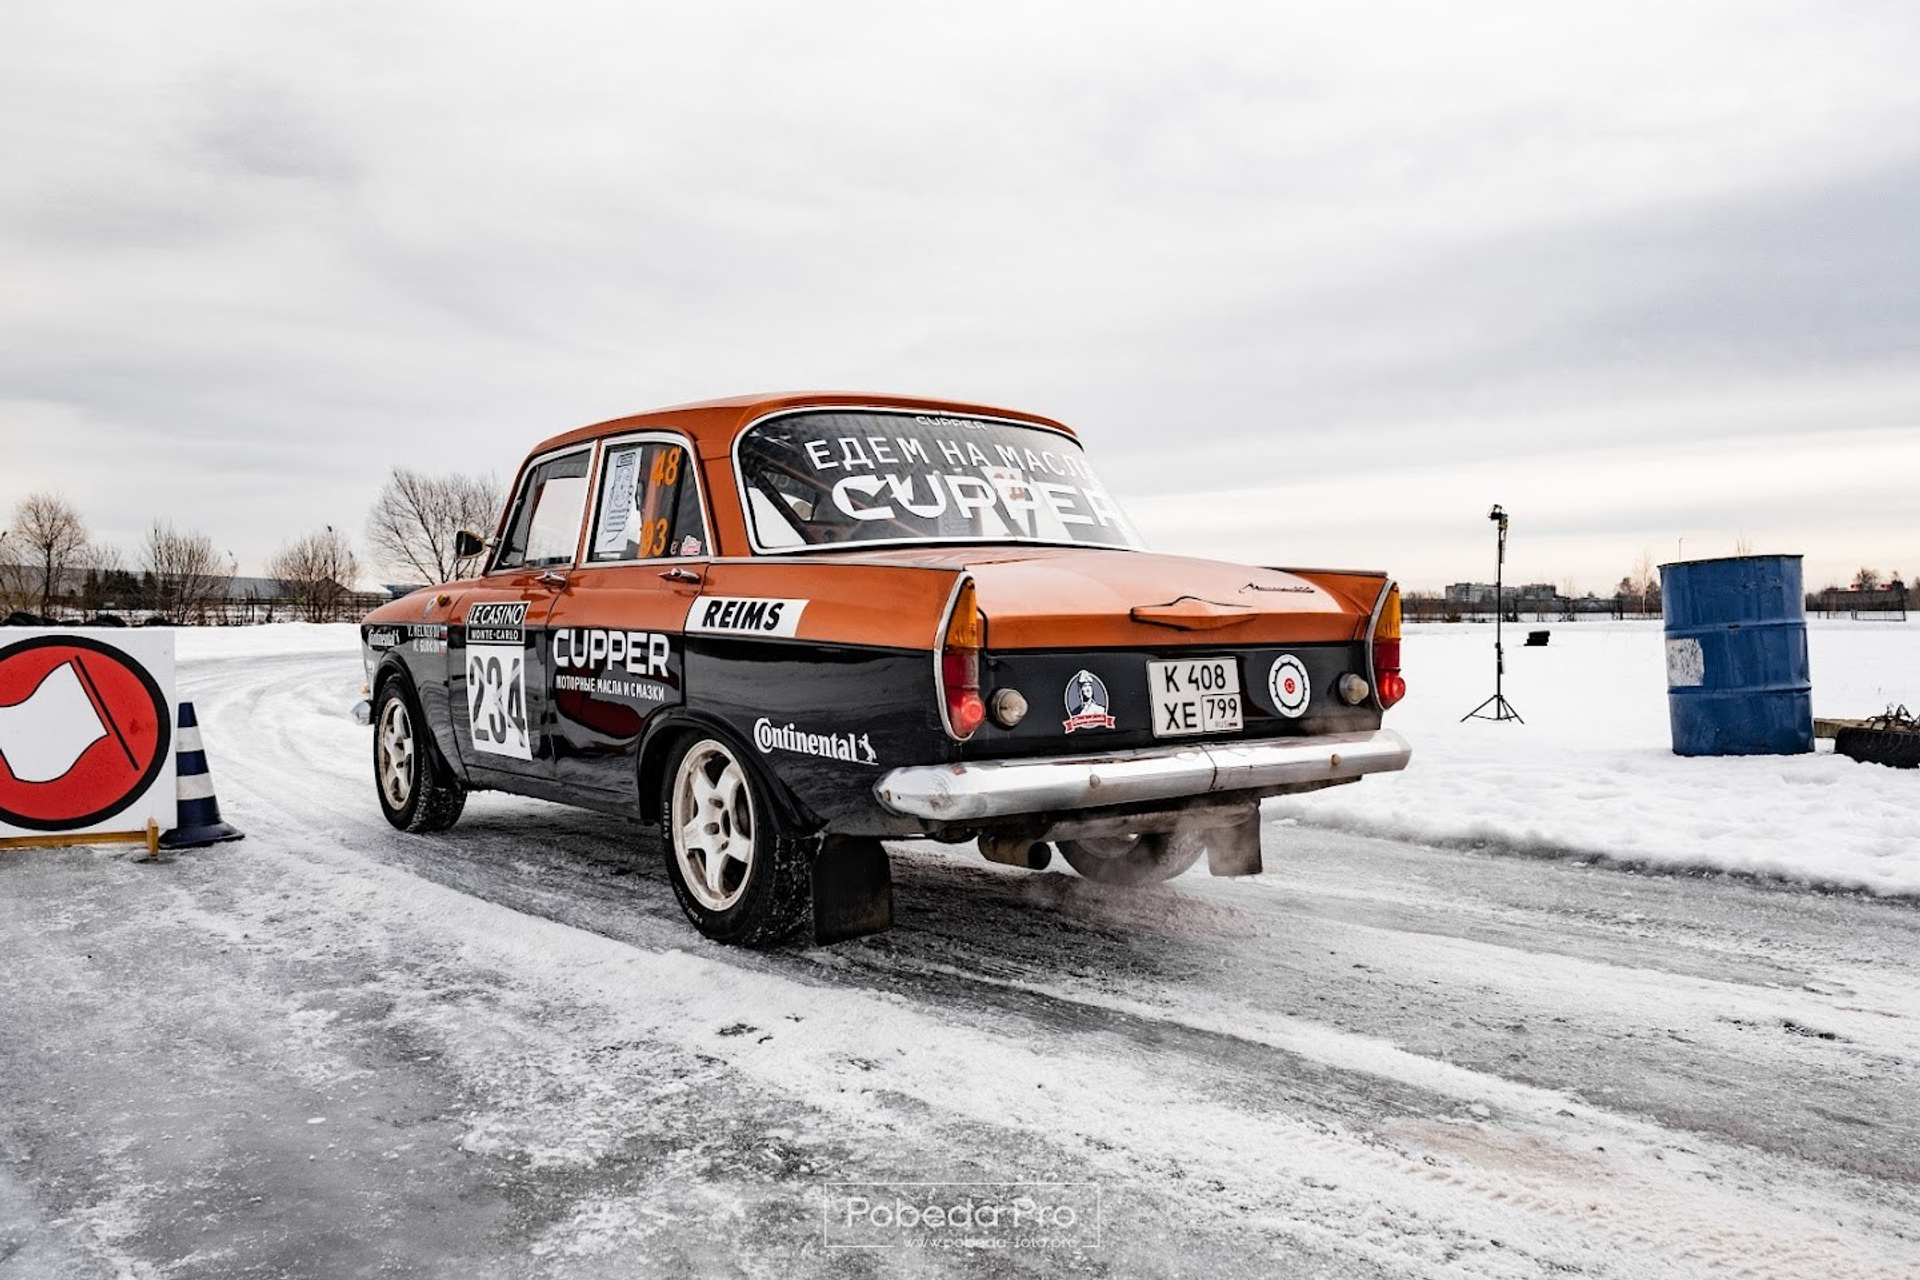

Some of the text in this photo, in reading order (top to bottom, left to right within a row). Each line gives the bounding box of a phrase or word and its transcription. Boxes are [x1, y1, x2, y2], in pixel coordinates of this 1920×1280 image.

[915, 416, 988, 431] CUPPER
[651, 447, 681, 487] 48
[804, 436, 938, 471] ЕДЕМ
[943, 439, 995, 467] НА
[831, 472, 1120, 529] CUPPER
[702, 599, 785, 631] REIMS
[552, 628, 671, 678] CUPPER
[555, 675, 665, 702] МОТОРНЫЕ МАСЛА И СМАЗКИ
[1187, 664, 1227, 691] 408
[469, 655, 526, 748] 234
[1206, 697, 1238, 720] 799
[753, 717, 859, 761] Continental
